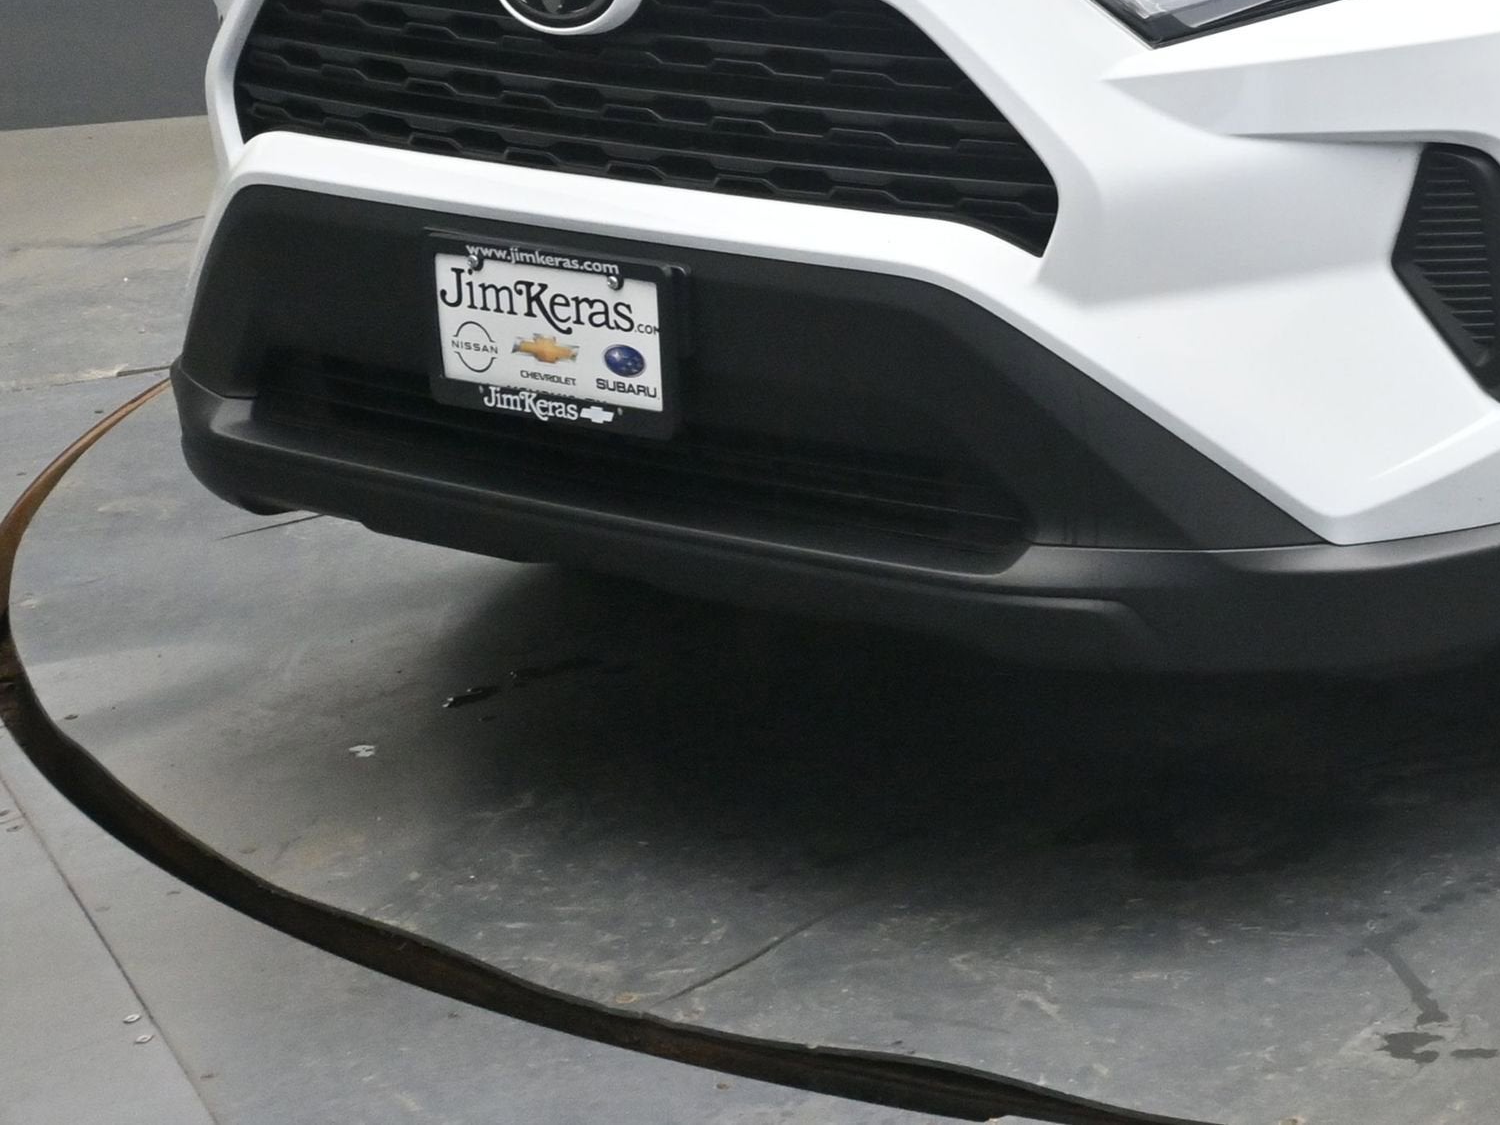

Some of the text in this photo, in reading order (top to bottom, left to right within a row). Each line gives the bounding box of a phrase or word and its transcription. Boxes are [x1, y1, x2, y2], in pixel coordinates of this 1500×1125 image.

[465, 244, 620, 275] www.jimkeras.com
[450, 339, 499, 355] NISSAN
[520, 369, 577, 386] CHEVROLET
[595, 377, 658, 398] SUBARU
[483, 385, 579, 422] JimKeras
